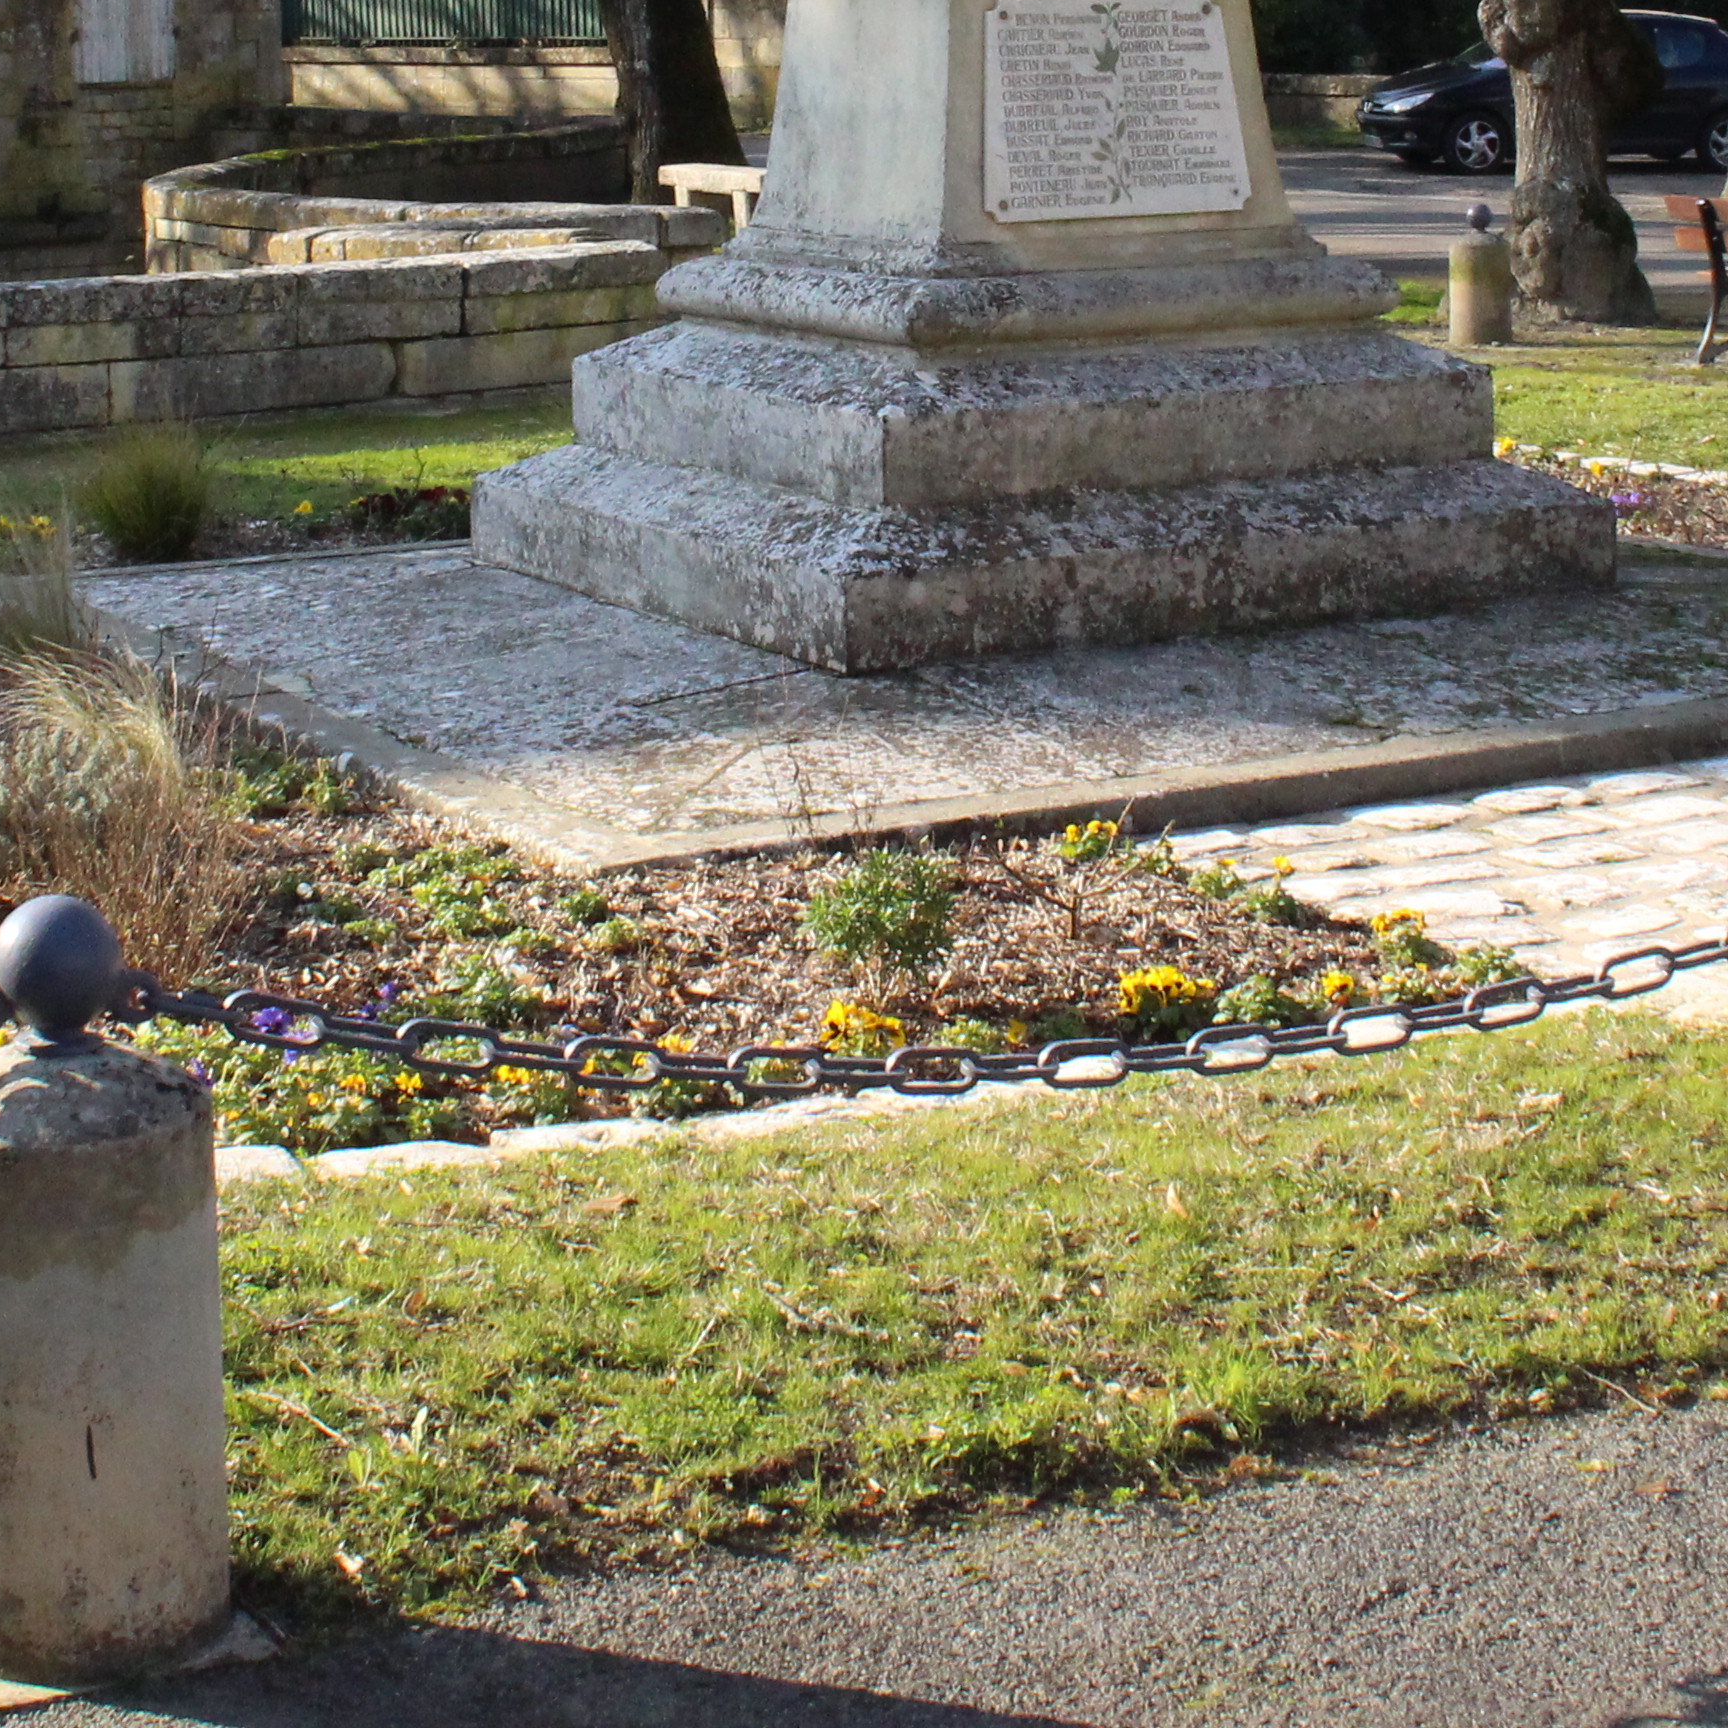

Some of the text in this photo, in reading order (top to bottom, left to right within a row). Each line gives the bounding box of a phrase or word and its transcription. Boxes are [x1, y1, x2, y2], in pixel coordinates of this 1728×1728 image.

[1117, 10, 1168, 23] GEORGET
[1118, 25, 1169, 38] GOURDON
[1128, 129, 1175, 142] RICHARD
[1011, 194, 1062, 209] GARNIER
